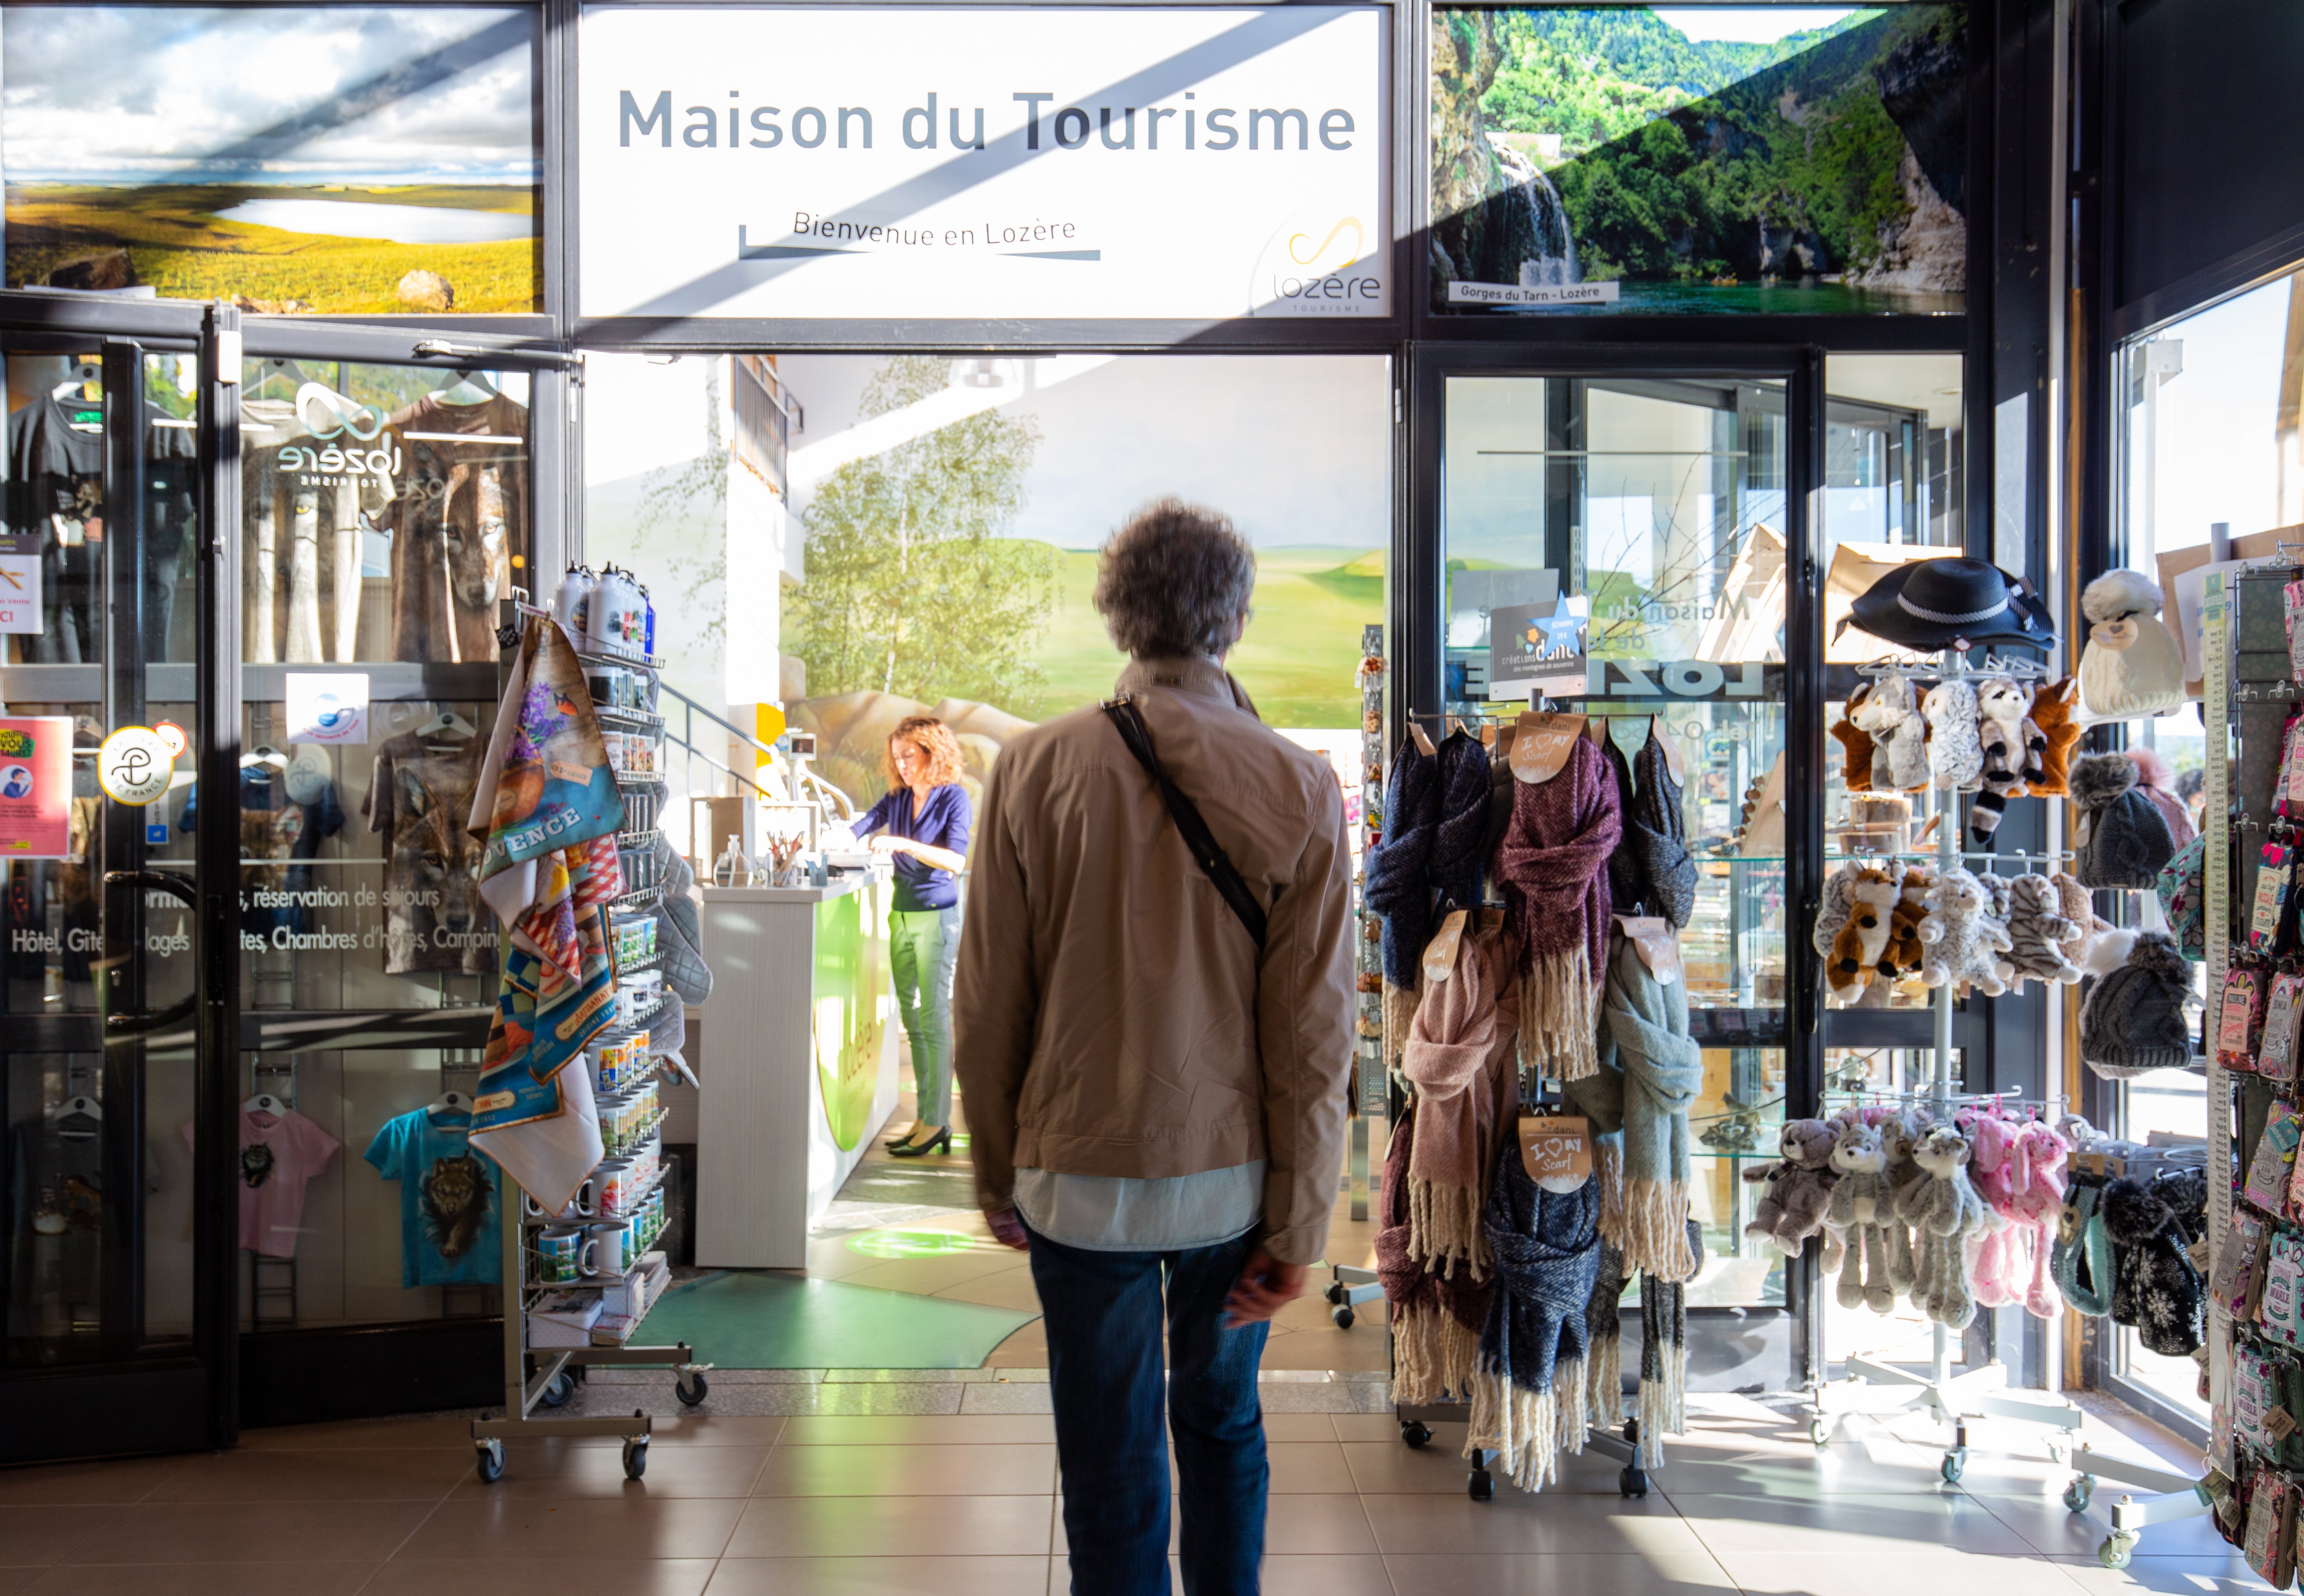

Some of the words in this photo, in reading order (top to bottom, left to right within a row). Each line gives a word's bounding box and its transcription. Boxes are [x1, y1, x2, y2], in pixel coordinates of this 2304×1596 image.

[618, 91, 873, 149] Maison
[902, 92, 985, 150] du
[1014, 92, 1356, 151] Tourisme
[793, 211, 935, 247] Bienvenue
[944, 229, 974, 246] en
[986, 217, 1077, 245] Lozère
[1274, 273, 1381, 299] lozère
[1461, 285, 1502, 300] Gorges
[1505, 289, 1519, 301] du
[1523, 291, 1549, 301] Tarn
[1560, 286, 1599, 299] Lozère
[1293, 305, 1360, 313] TOURISME
[1552, 619, 1574, 629] ECHARPE
[1502, 653, 1536, 665] créations
[1522, 663, 1546, 672] montagnes
[1521, 735, 1533, 751] I
[1522, 747, 1555, 763] Scarf
[125, 777, 162, 797] FRANCE
[253, 885, 349, 908] réservation
[354, 883, 377, 907] de
[12, 927, 64, 955] Hôtel,
[272, 924, 358, 950] Chambres
[1530, 1143, 1546, 1161] I
[1541, 1152, 1572, 1171] Scarf
[2282, 1349, 2287, 1357] 80
[2285, 1474, 2291, 1483] 83
